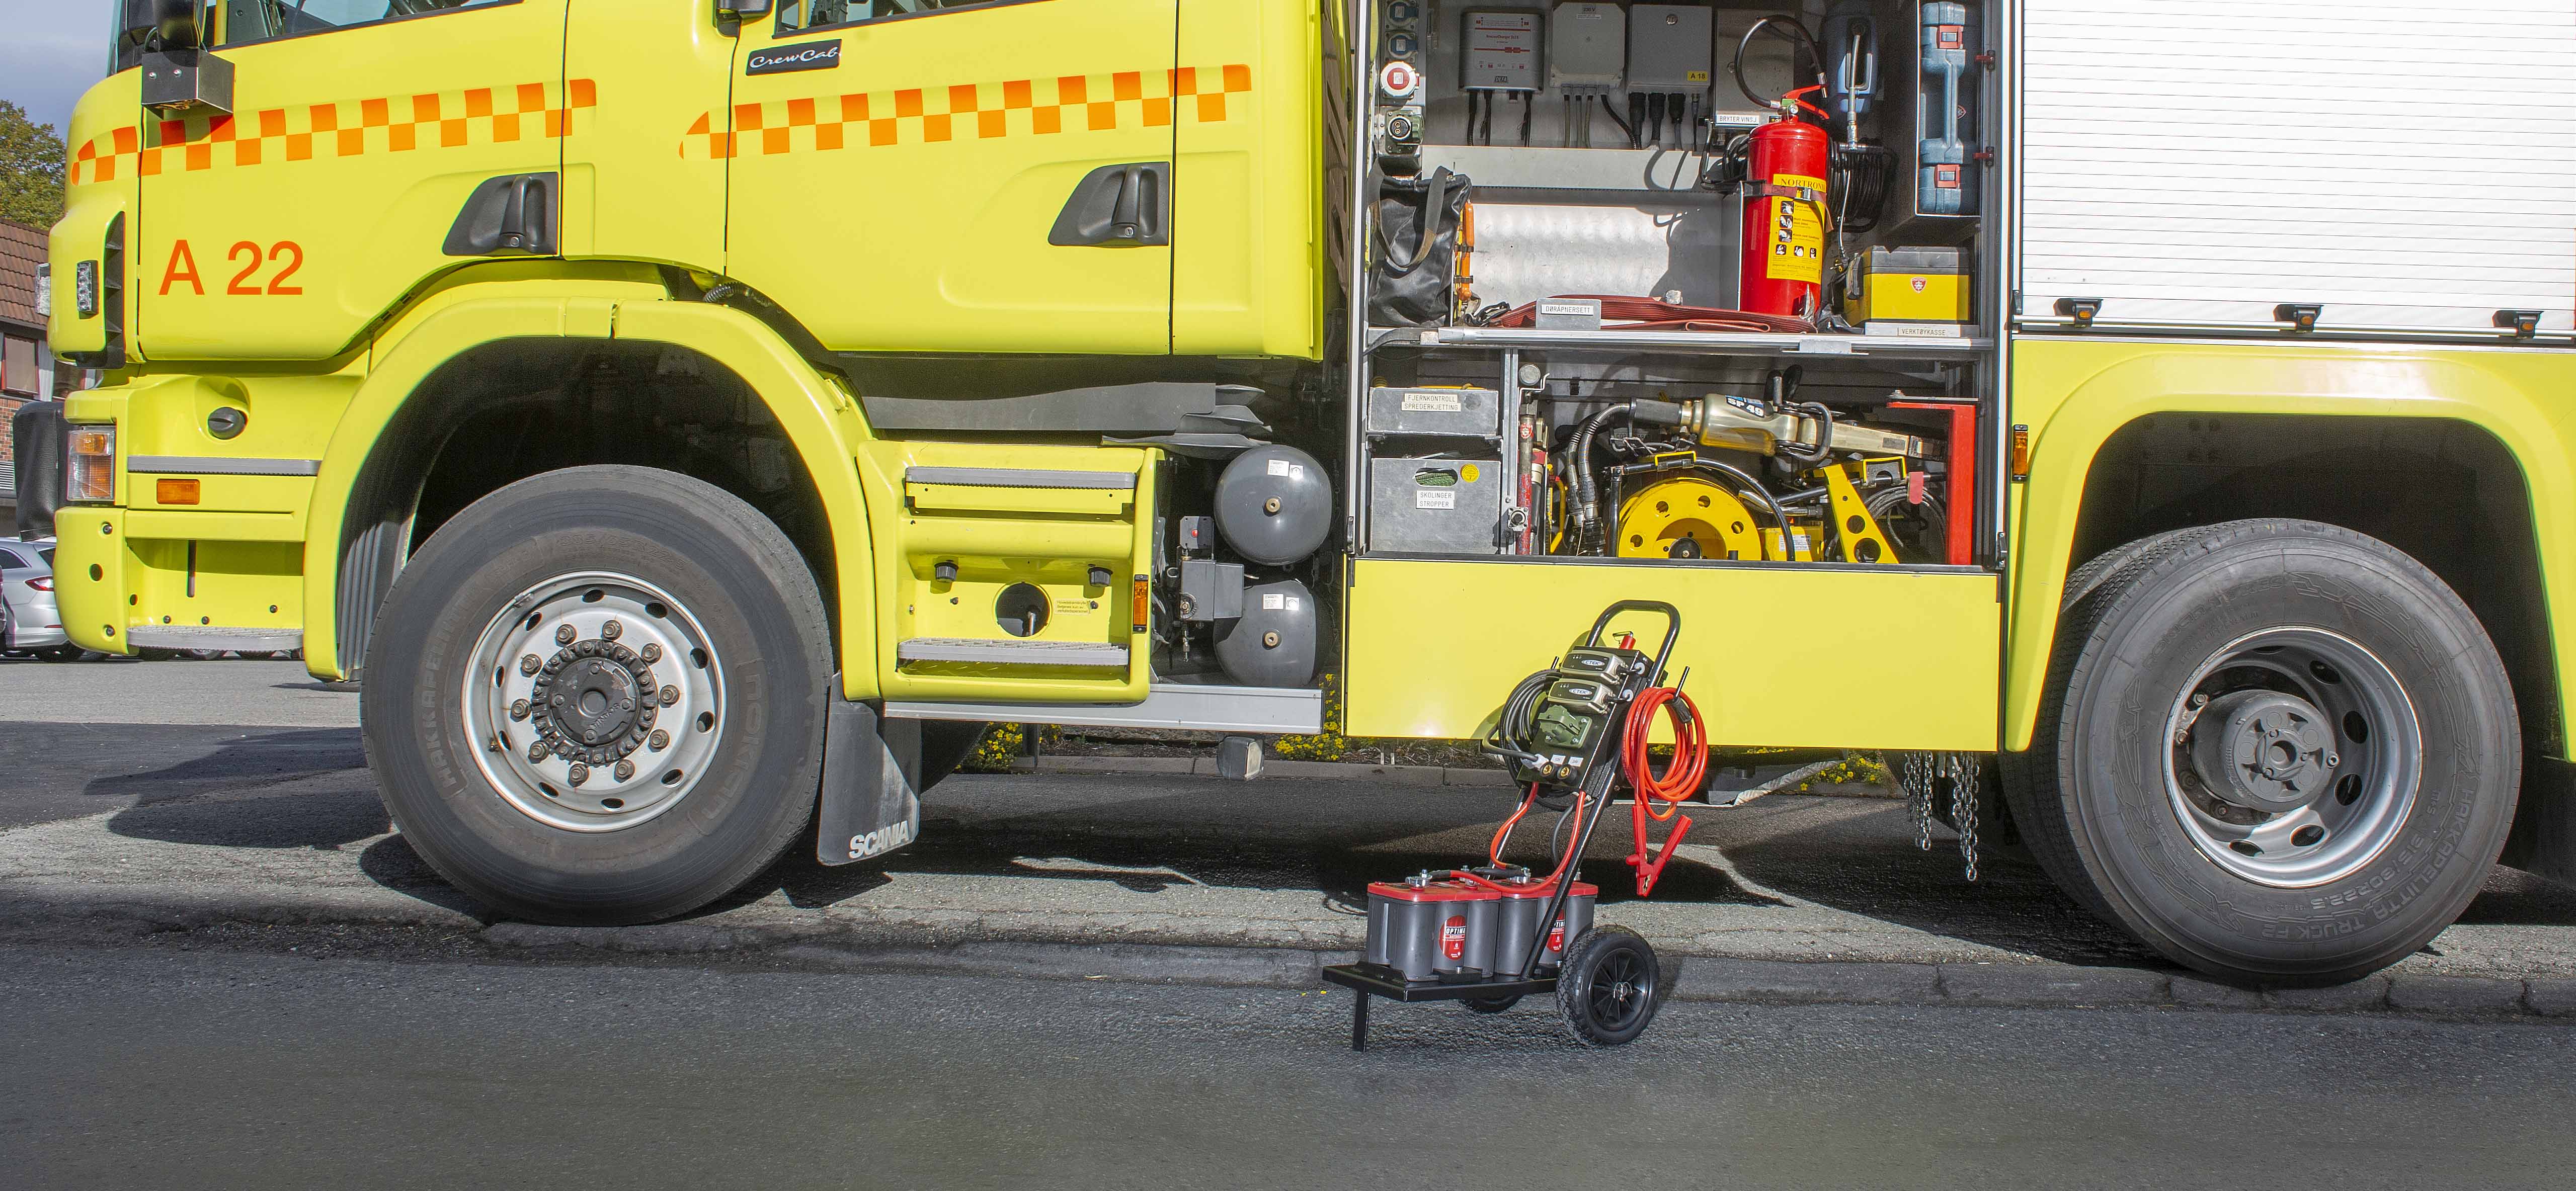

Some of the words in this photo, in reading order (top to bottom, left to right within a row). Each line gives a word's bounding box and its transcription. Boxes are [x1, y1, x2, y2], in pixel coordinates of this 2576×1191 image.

[750, 47, 839, 68] CrewCab
[158, 239, 205, 295] A
[227, 241, 303, 295] 22
[1546, 305, 1590, 313] DØRÅPNERSETT
[1727, 397, 1745, 407] SP
[1746, 404, 1764, 416] 49
[849, 820, 909, 859] SCANIA
[2310, 834, 2424, 910] 315/80R22.5
[2297, 916, 2365, 939] TRUCK
